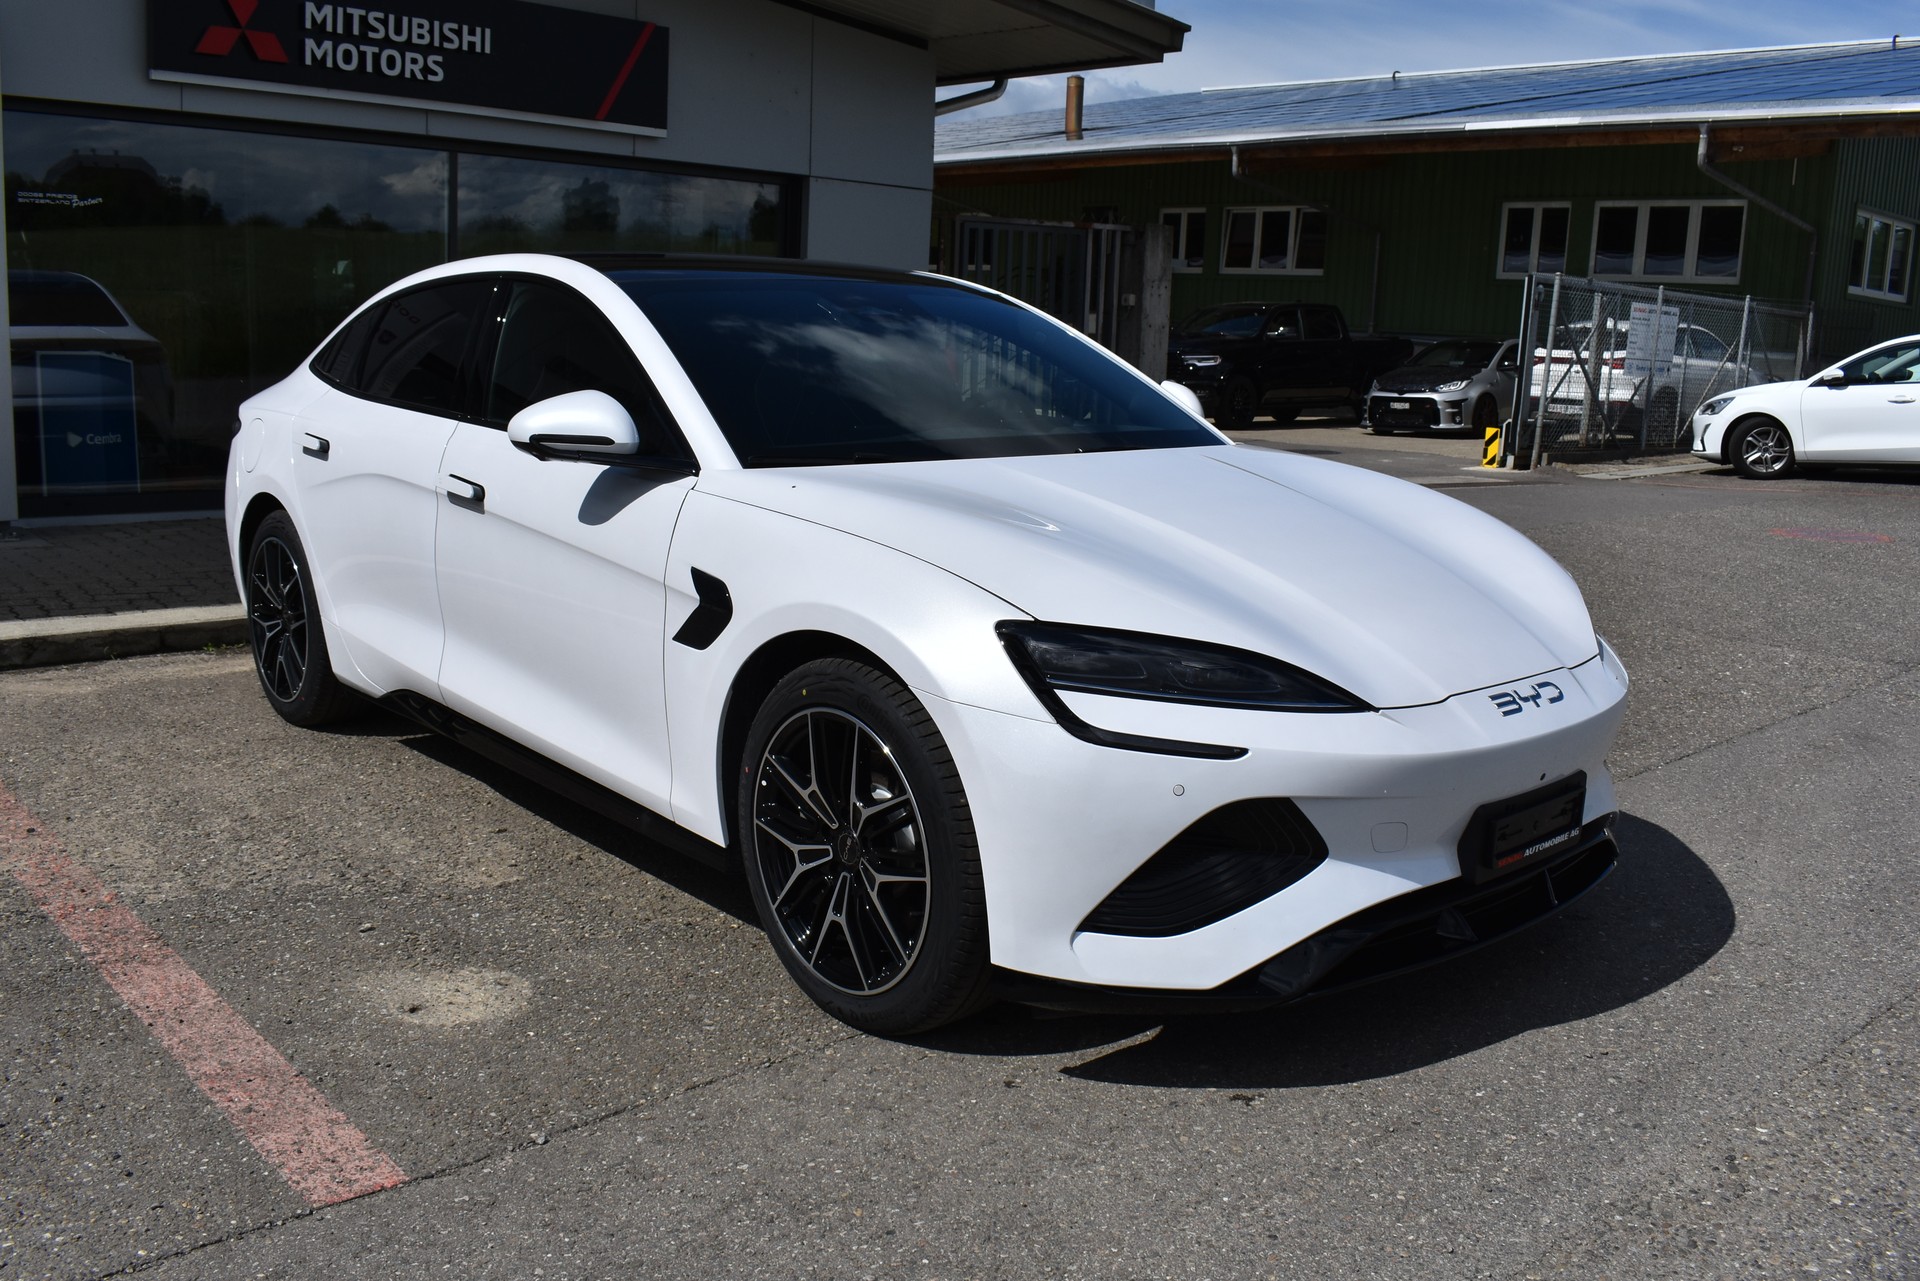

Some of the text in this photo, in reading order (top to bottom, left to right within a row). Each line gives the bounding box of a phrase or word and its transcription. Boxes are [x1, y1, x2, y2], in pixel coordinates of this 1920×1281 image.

[305, 2, 491, 54] MITSUBISHI
[305, 38, 444, 82] MOTORS
[71, 197, 103, 208] Partner
[86, 432, 122, 444] Cembra
[1488, 681, 1565, 717] BYD
[1523, 827, 1580, 857] AUTOMOBILE AG
